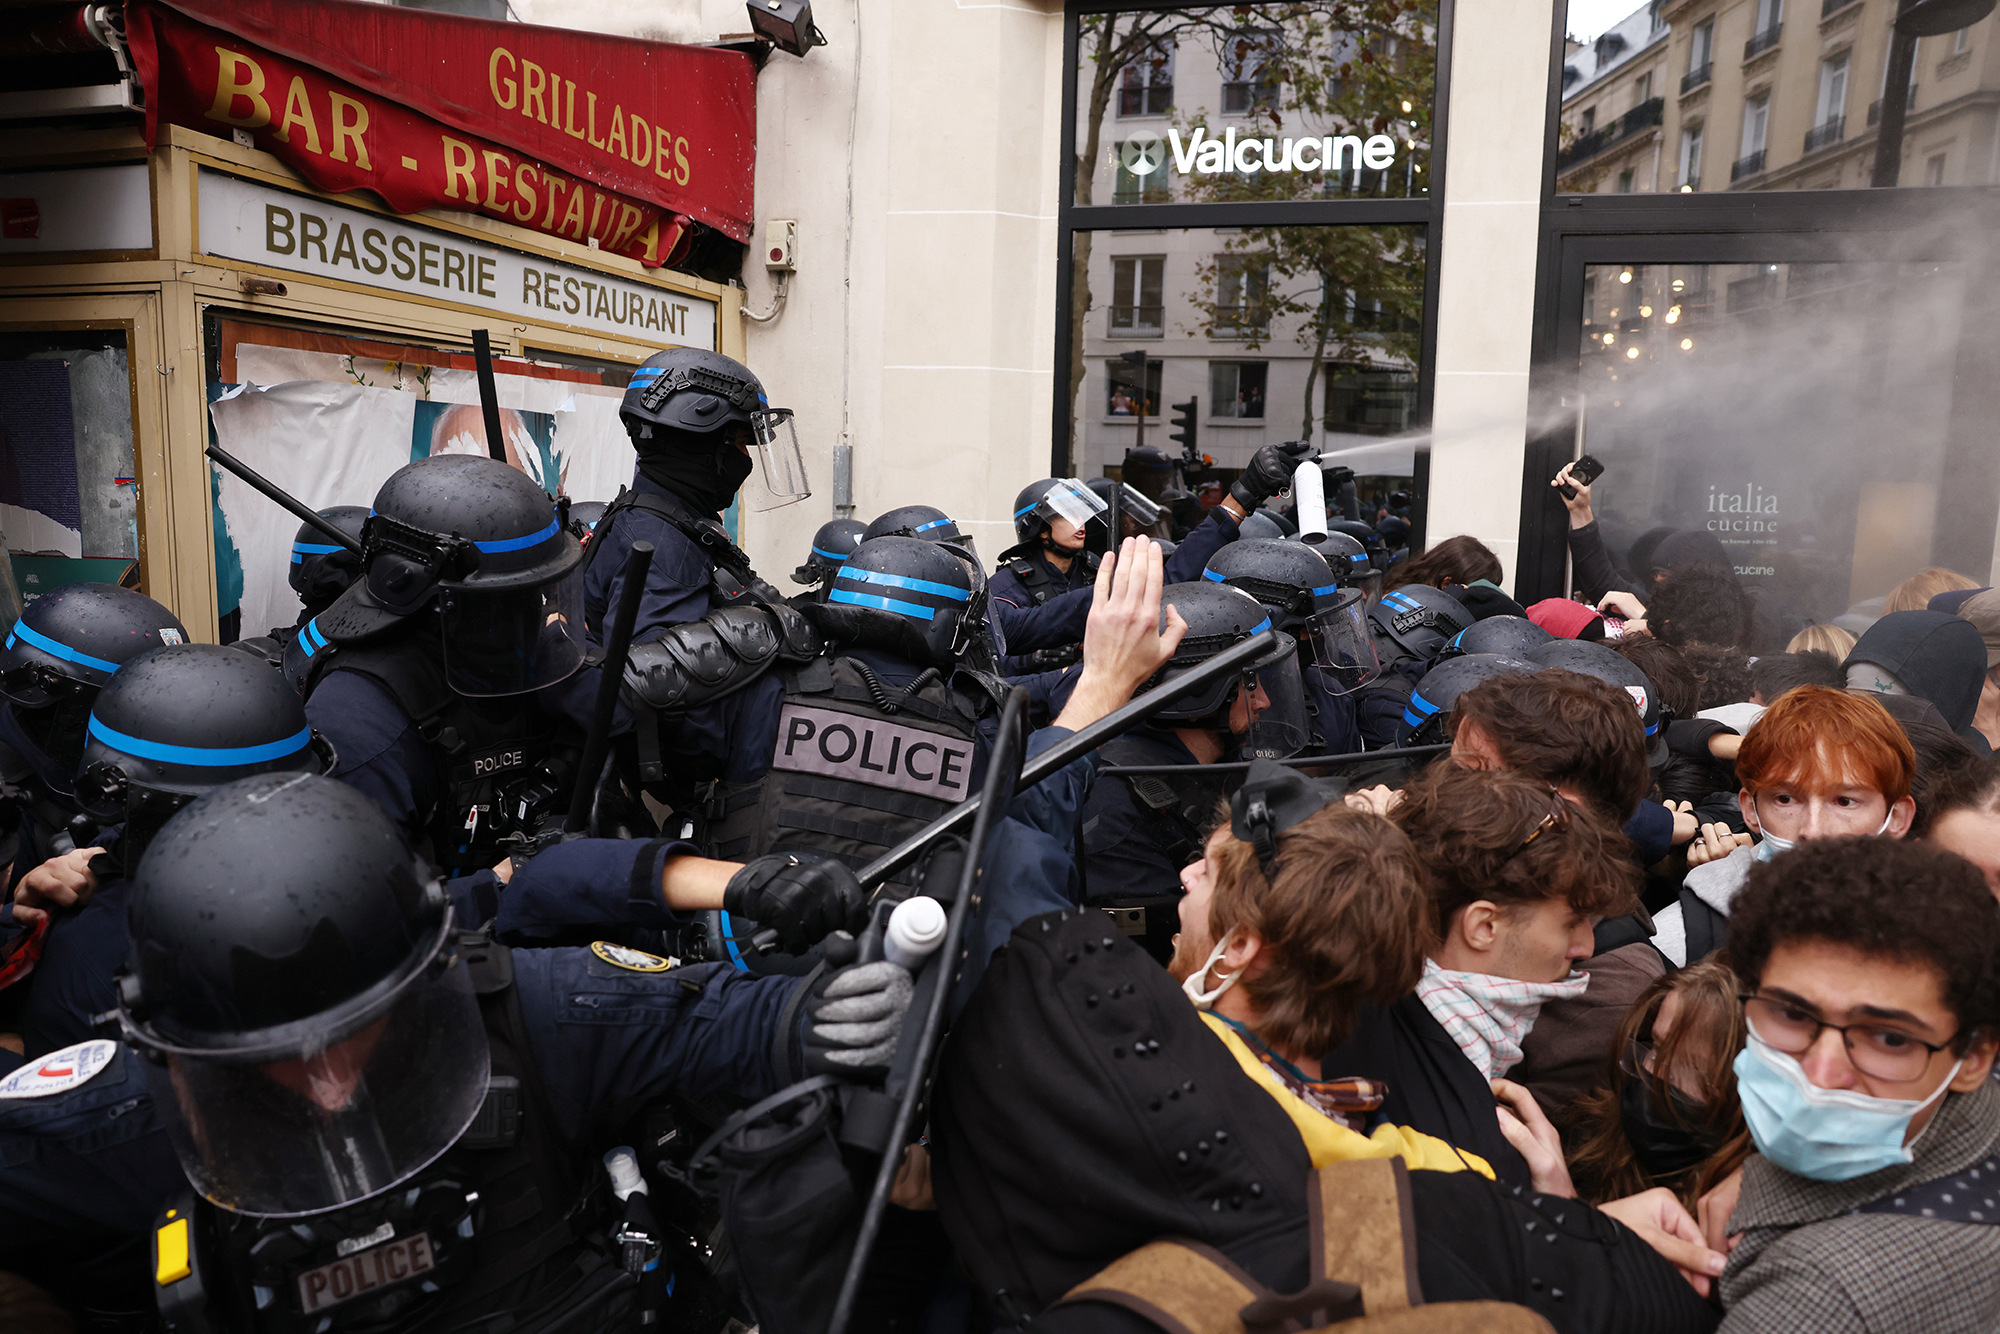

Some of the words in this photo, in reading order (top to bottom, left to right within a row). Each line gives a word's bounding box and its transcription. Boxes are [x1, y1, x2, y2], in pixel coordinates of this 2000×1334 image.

[489, 47, 690, 186] GRILLADES
[204, 46, 372, 171] BAR
[442, 135, 684, 264] RESTAURA
[1167, 126, 1396, 174] Valcucine
[265, 203, 497, 298] BRASSERIE
[523, 267, 689, 336] RESTAURANT
[1707, 482, 1779, 514] italia
[1706, 515, 1778, 533] cucine
[1732, 565, 1775, 576] cucine
[474, 750, 522, 775] POLICE
[784, 717, 966, 790] POLICE
[1252, 749, 1276, 759] OLICE
[304, 1237, 429, 1308] POLICE
